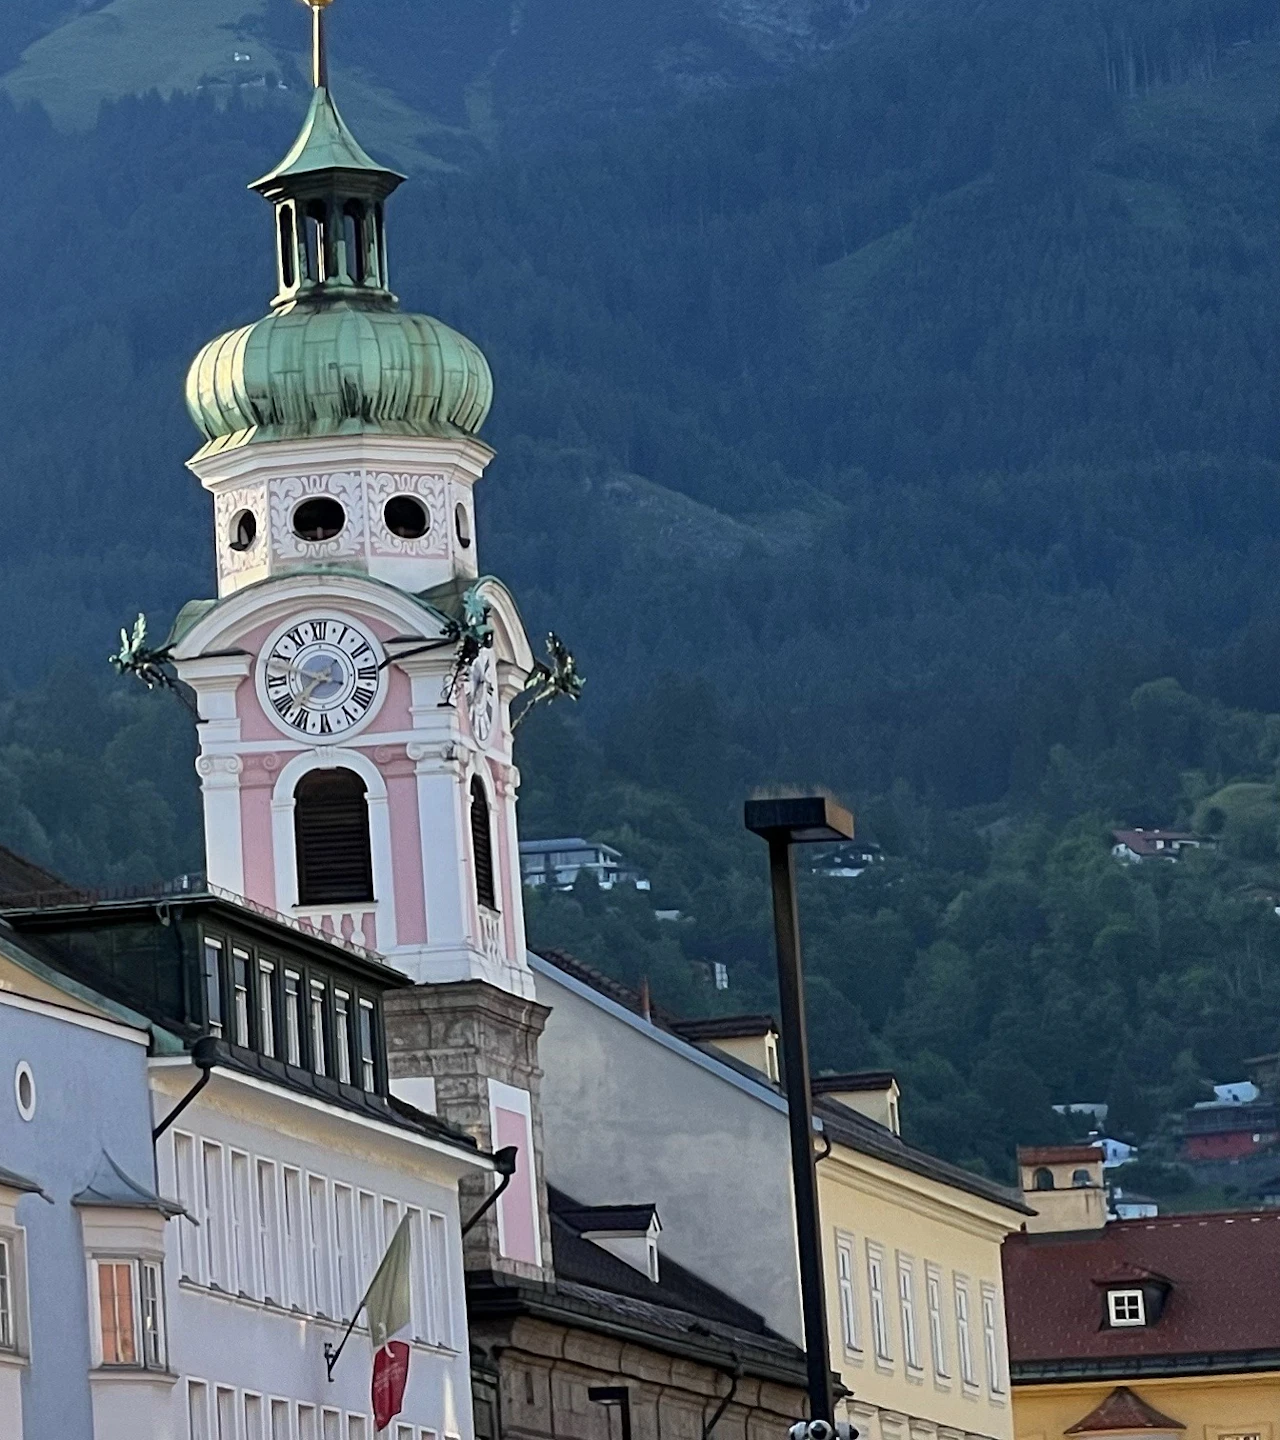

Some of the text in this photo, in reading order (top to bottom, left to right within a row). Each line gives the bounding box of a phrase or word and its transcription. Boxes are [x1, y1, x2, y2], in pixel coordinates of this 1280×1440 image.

[286, 628, 305, 651] XI
[309, 622, 327, 641] XII
[337, 626, 349, 645] I
[350, 641, 370, 660] II
[358, 664, 377, 681] III
[351, 686, 375, 711] IIII
[341, 705, 357, 726] V
